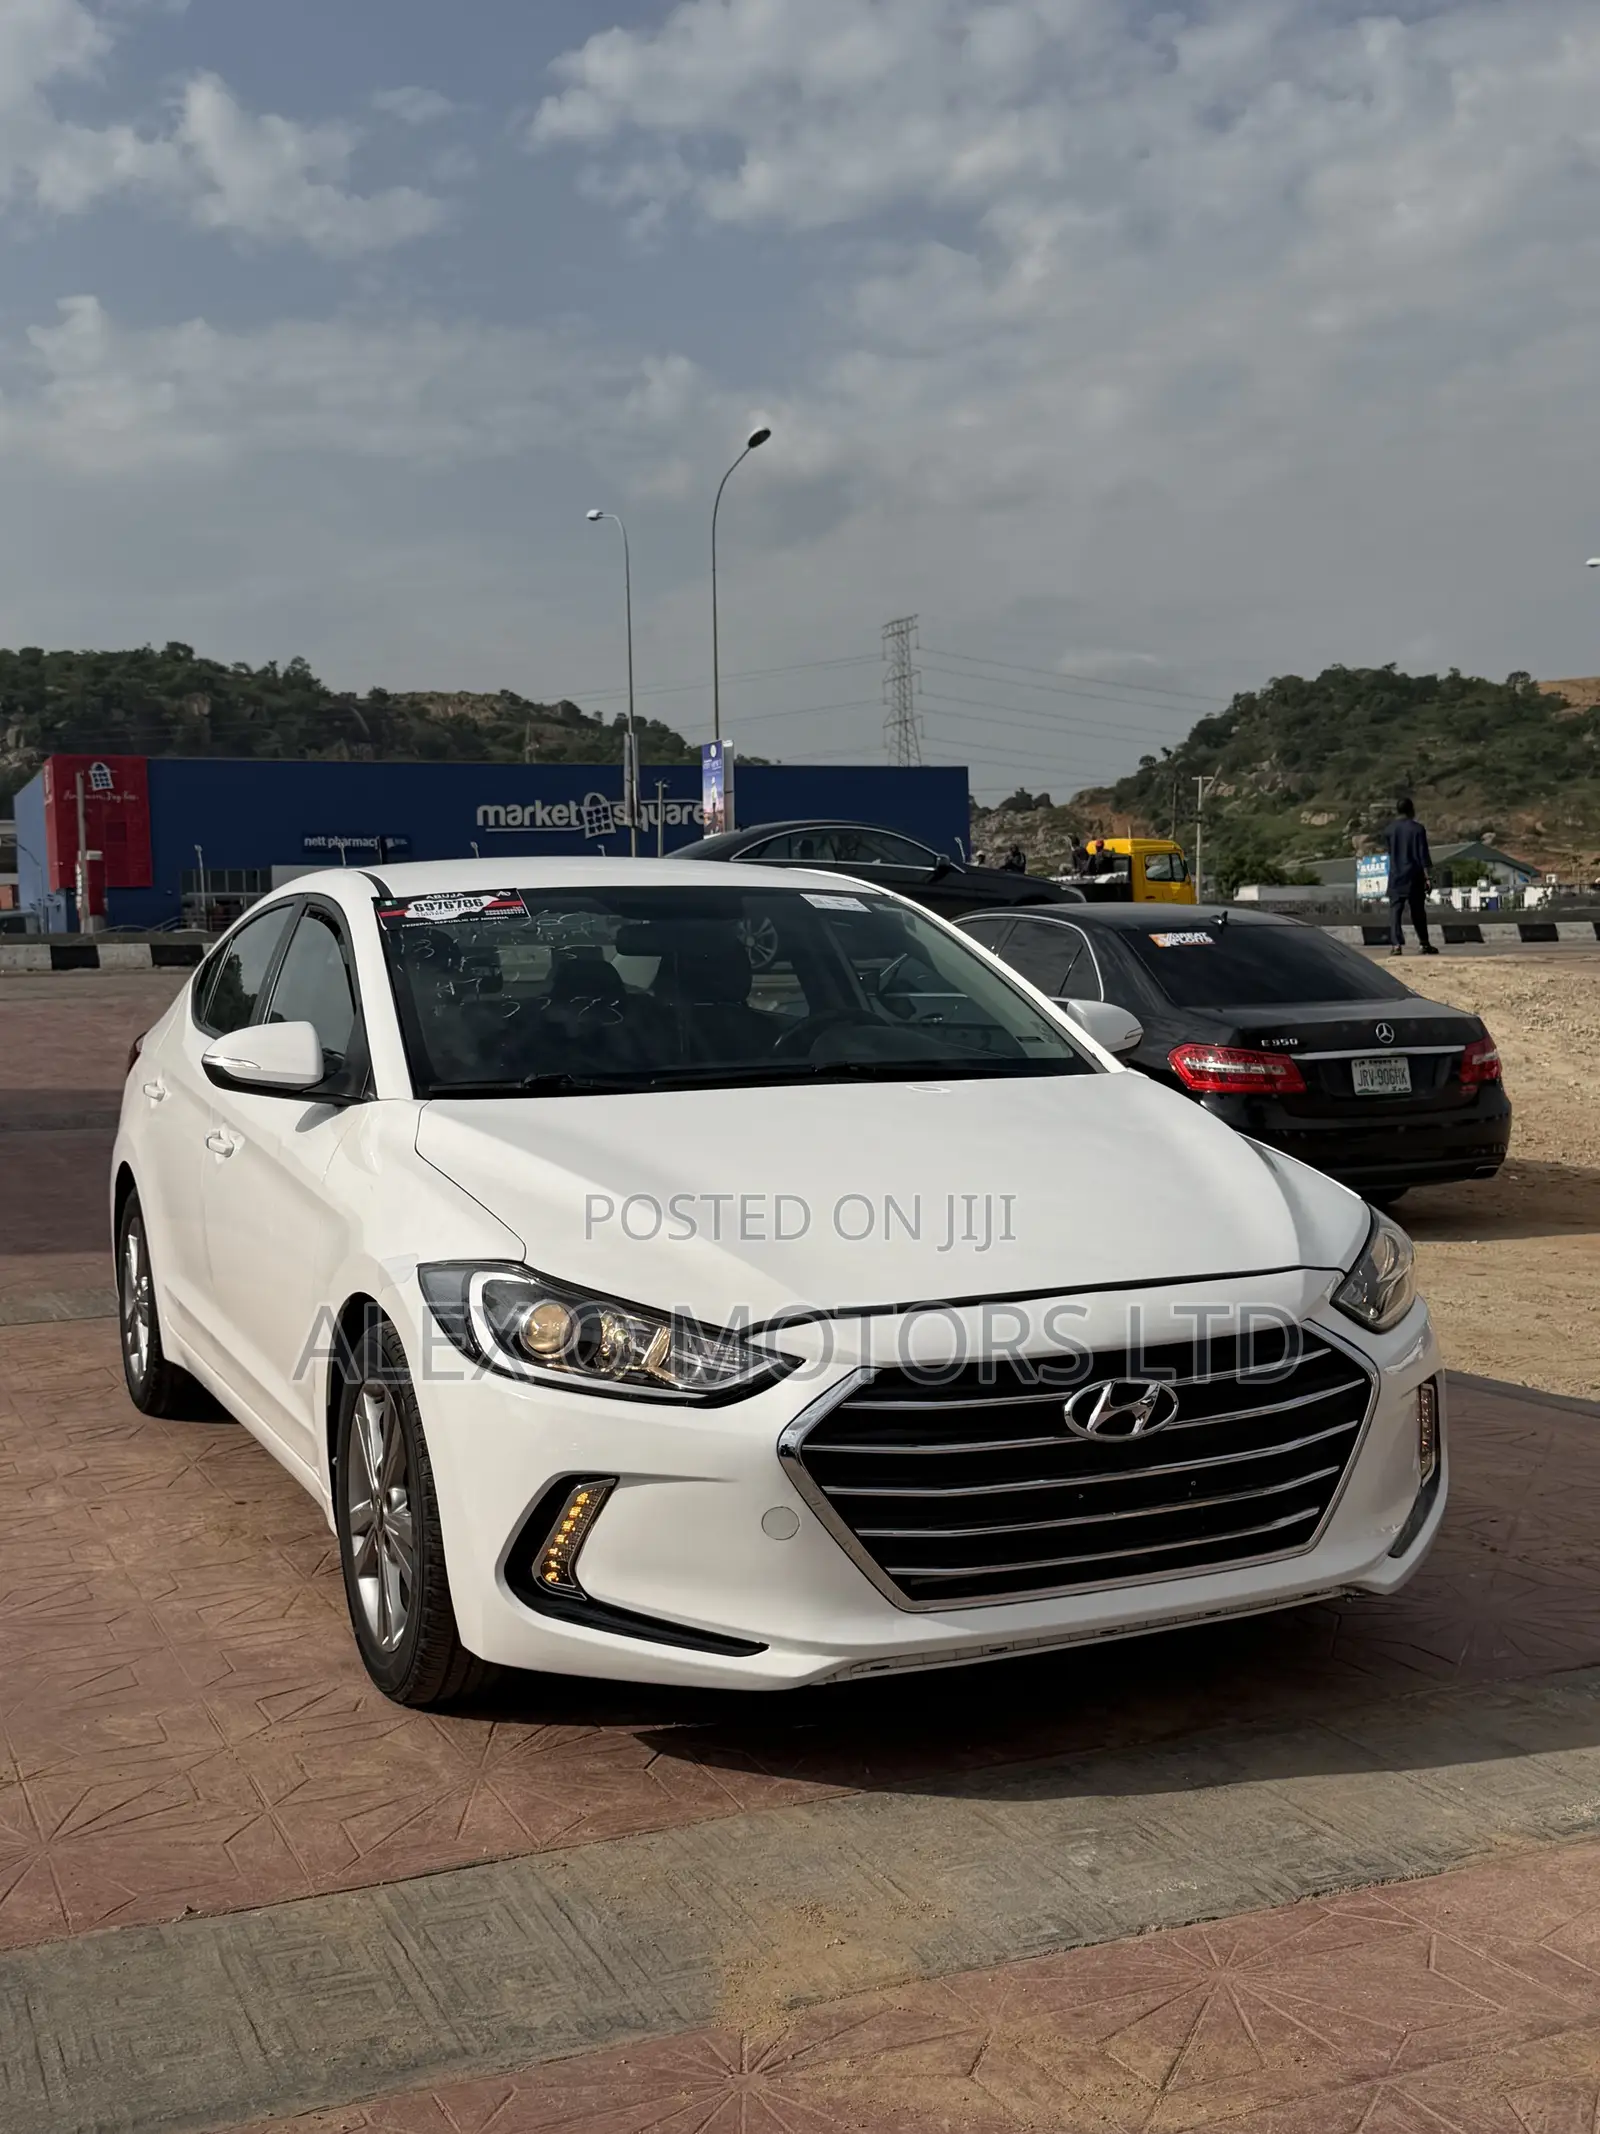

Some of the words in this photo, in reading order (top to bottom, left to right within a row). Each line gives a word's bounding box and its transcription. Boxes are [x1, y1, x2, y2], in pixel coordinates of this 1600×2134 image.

[476, 800, 580, 827] market
[304, 836, 326, 847] nett
[328, 835, 380, 850] pharmacy
[426, 891, 465, 900] ABUJA
[413, 898, 484, 913] 6976786
[1357, 1067, 1408, 1087] JRV-906HK
